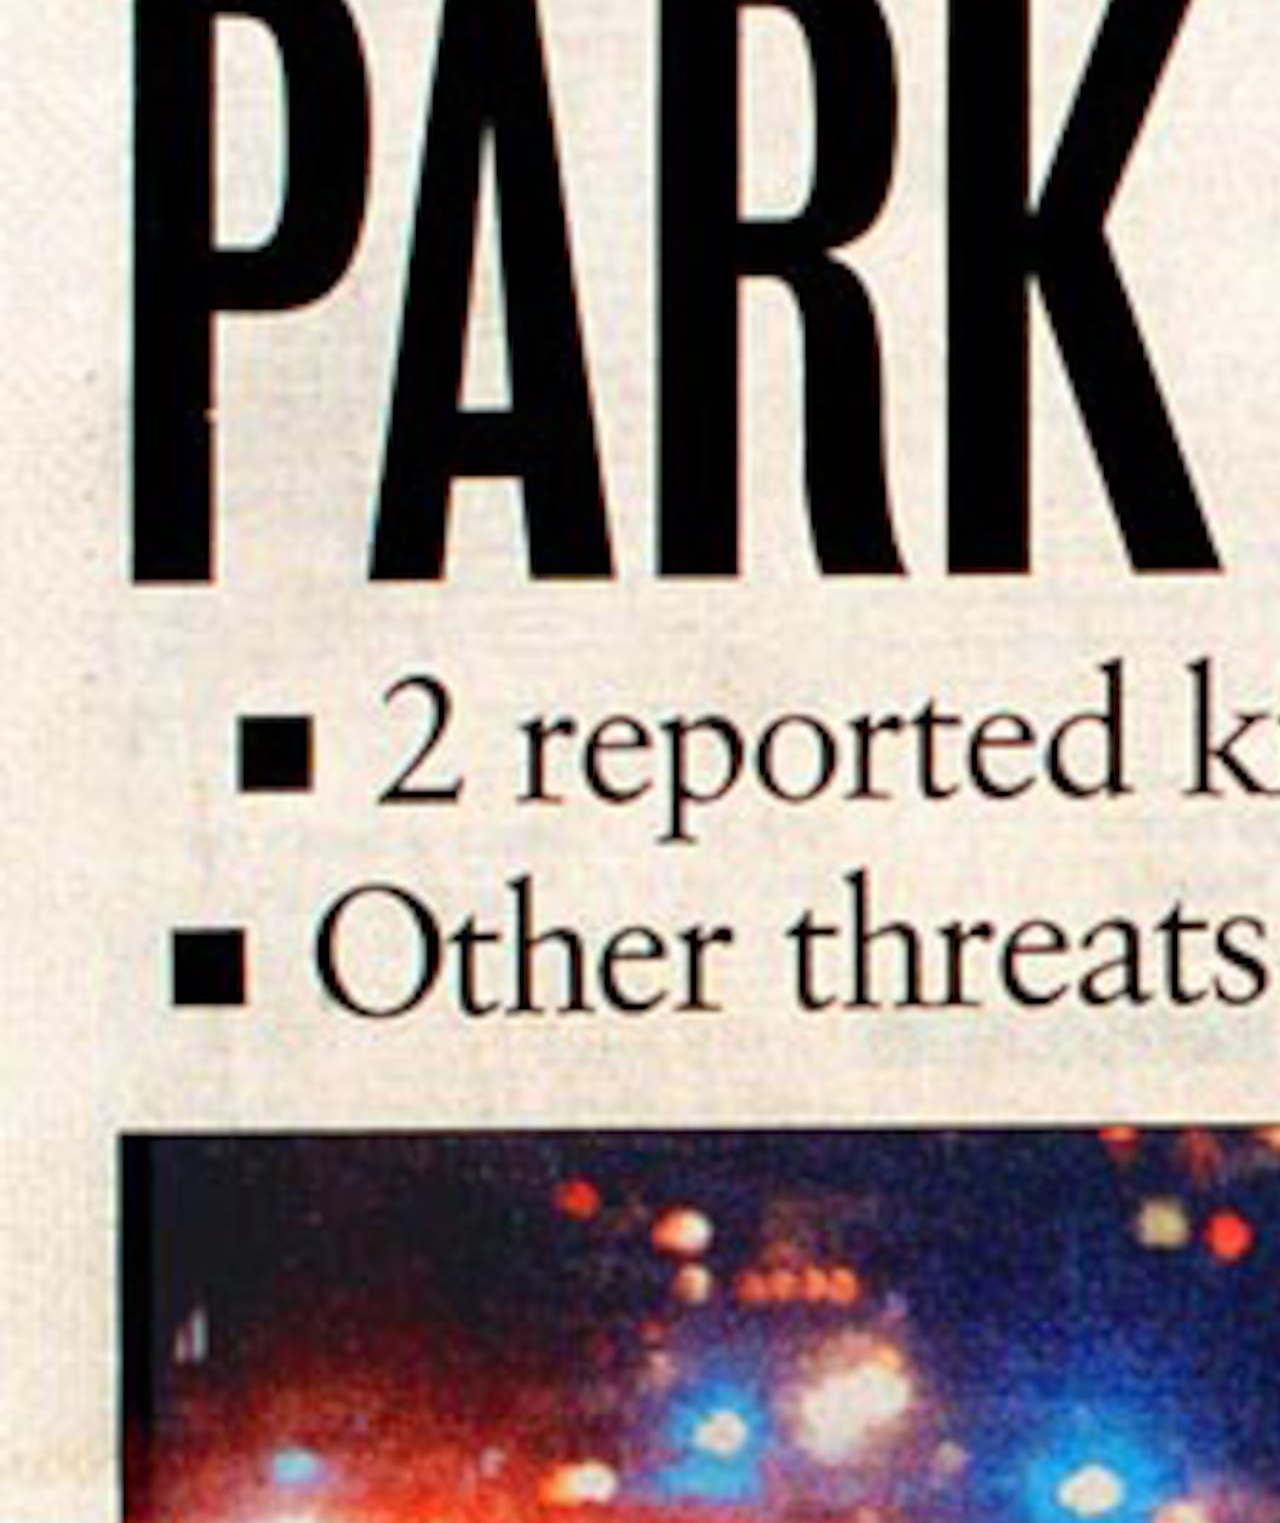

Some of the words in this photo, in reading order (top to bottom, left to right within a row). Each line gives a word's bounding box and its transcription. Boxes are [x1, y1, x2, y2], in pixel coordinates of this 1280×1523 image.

[381, 675, 462, 804] 2
[522, 660, 1126, 844] reported
[315, 874, 733, 1018] Other
[789, 867, 1267, 1011] threats
